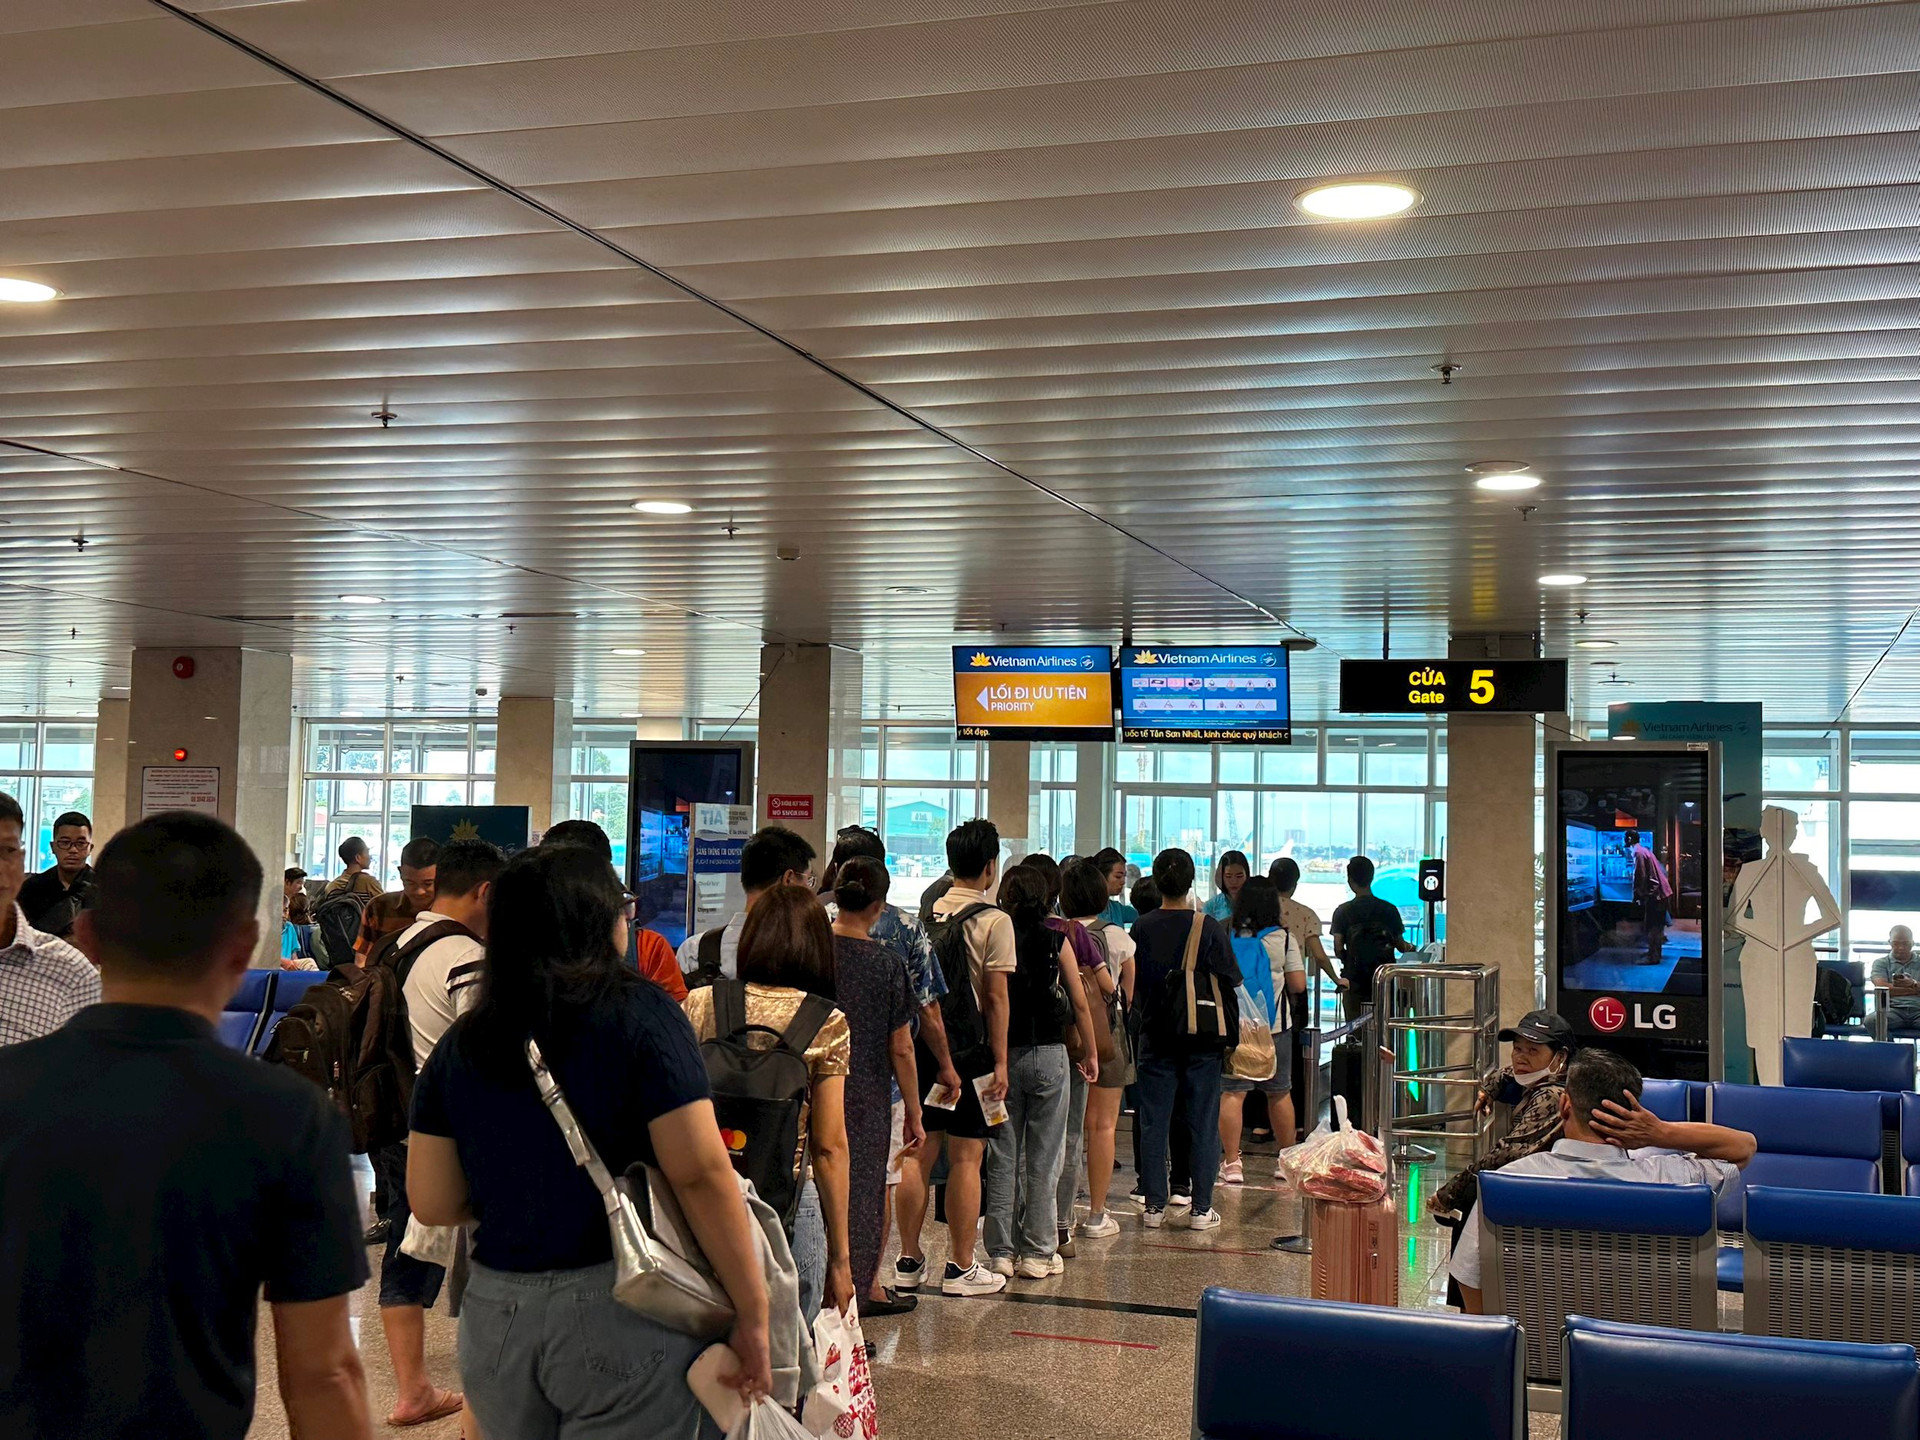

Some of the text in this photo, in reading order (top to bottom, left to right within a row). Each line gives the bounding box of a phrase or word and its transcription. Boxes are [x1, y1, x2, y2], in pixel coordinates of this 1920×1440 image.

[990, 655, 1077, 667] Vietnam Airlines
[1157, 652, 1257, 664] Vietnam Airlines
[1408, 666, 1447, 686] CỬA
[990, 683, 1087, 700] LỐI ĐI ƯU TIÊN
[1469, 669, 1495, 704] 5
[1408, 690, 1445, 704] Gate
[990, 701, 1035, 712] PRIORITY
[1642, 720, 1733, 732] Vietnam Airlines
[1634, 1003, 1677, 1030] LG
